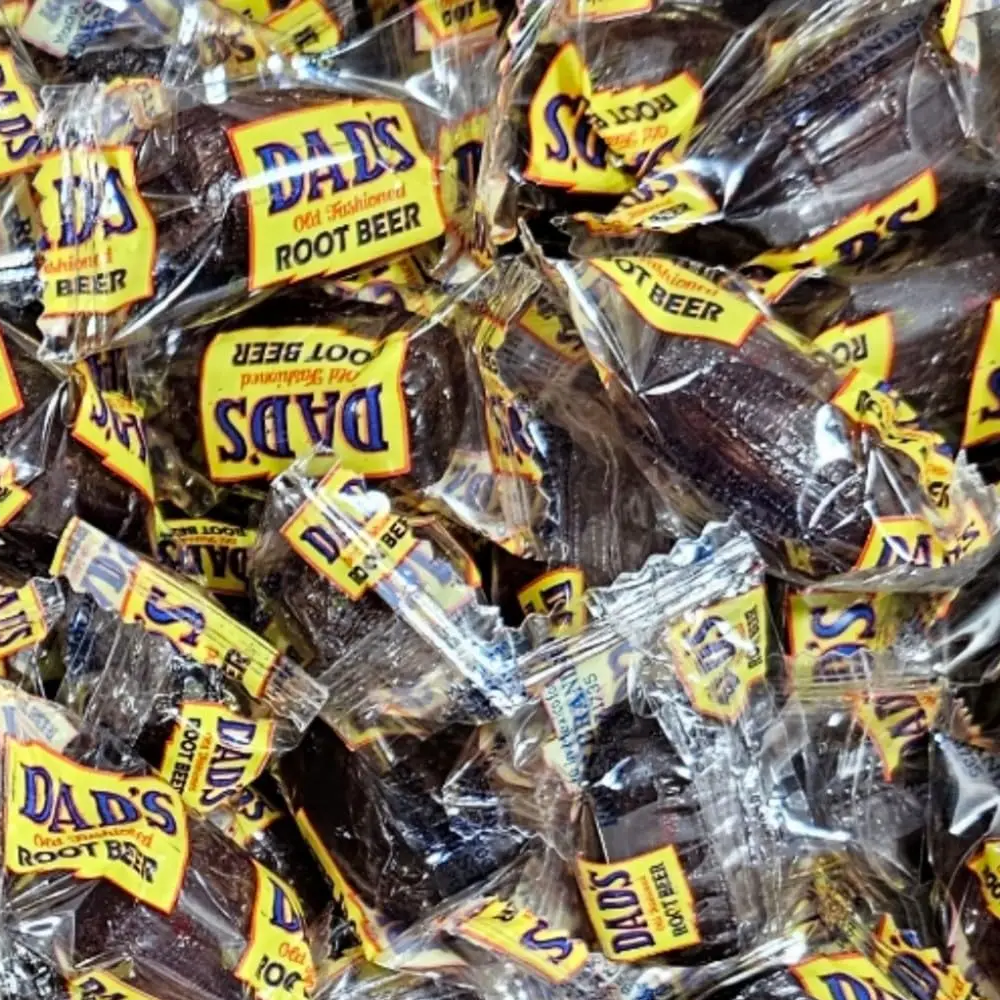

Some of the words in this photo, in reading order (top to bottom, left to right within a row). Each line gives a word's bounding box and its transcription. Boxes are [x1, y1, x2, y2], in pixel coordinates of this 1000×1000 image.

[255, 112, 416, 216] DAD'S
[293, 210, 322, 234] Old
[326, 184, 407, 222] Fashioned
[275, 227, 348, 273] ROOT
[357, 202, 422, 248] BEER
[56, 269, 128, 298] BEER
[648, 284, 725, 324] BEER
[232, 341, 304, 367] BEER
[303, 341, 374, 366] OOT
[213, 383, 389, 464] DAD'S
[19, 761, 178, 837] DAD'S
[17, 840, 98, 867] ROOT
[99, 840, 160, 885] BEER
[587, 867, 657, 955] DAD'S
